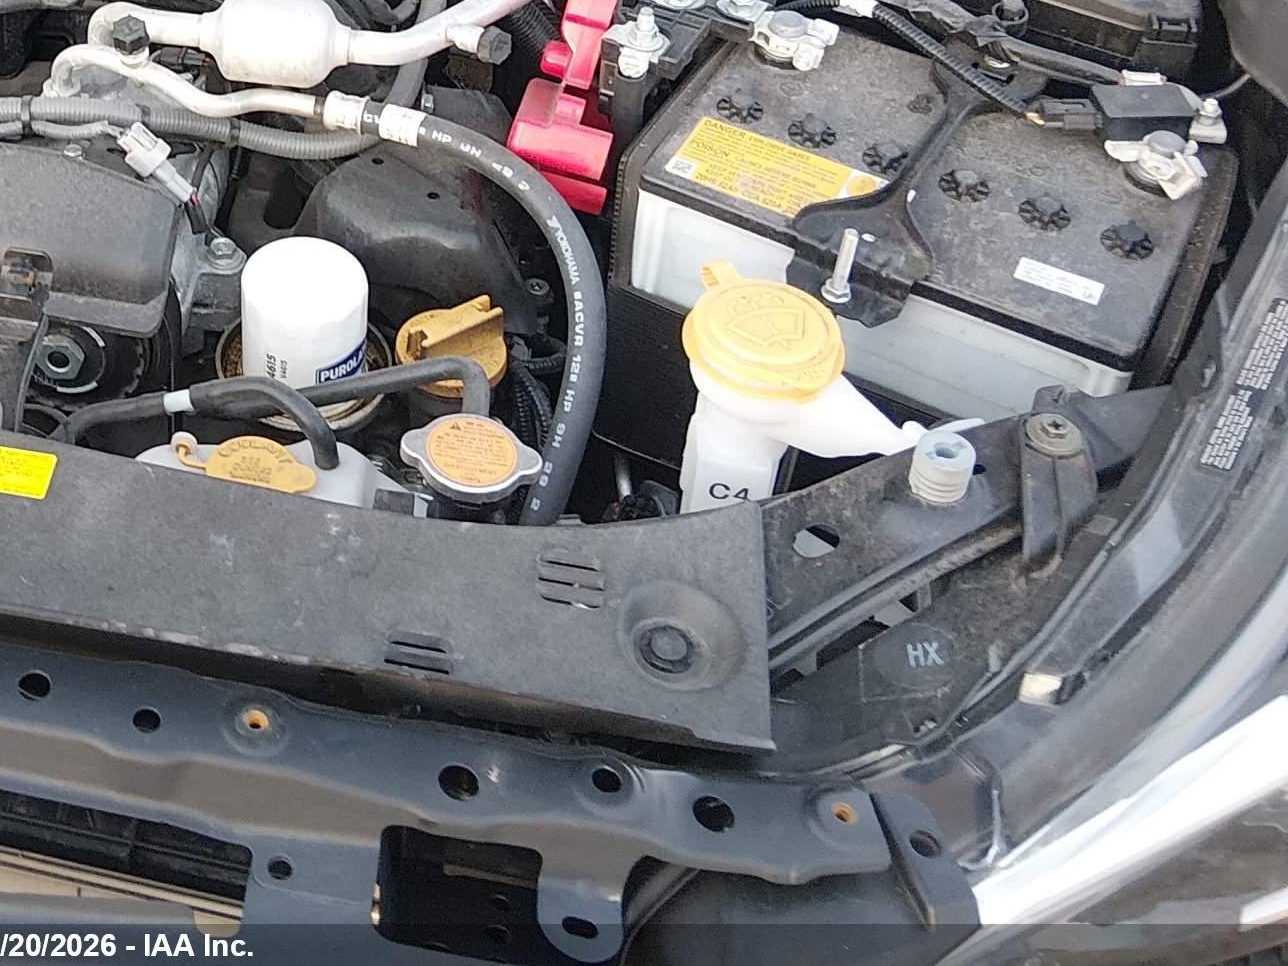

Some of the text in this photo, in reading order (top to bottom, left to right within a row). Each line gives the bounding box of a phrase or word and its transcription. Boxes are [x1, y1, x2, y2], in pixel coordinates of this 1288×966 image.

[703, 119, 746, 138] DANGER
[691, 140, 730, 157] POISON
[554, 224, 580, 285] YOKOHAMA
[563, 389, 575, 412] HP
[217, 439, 293, 464] COOLANT
[709, 483, 749, 500] C4
[906, 641, 945, 668] HX
